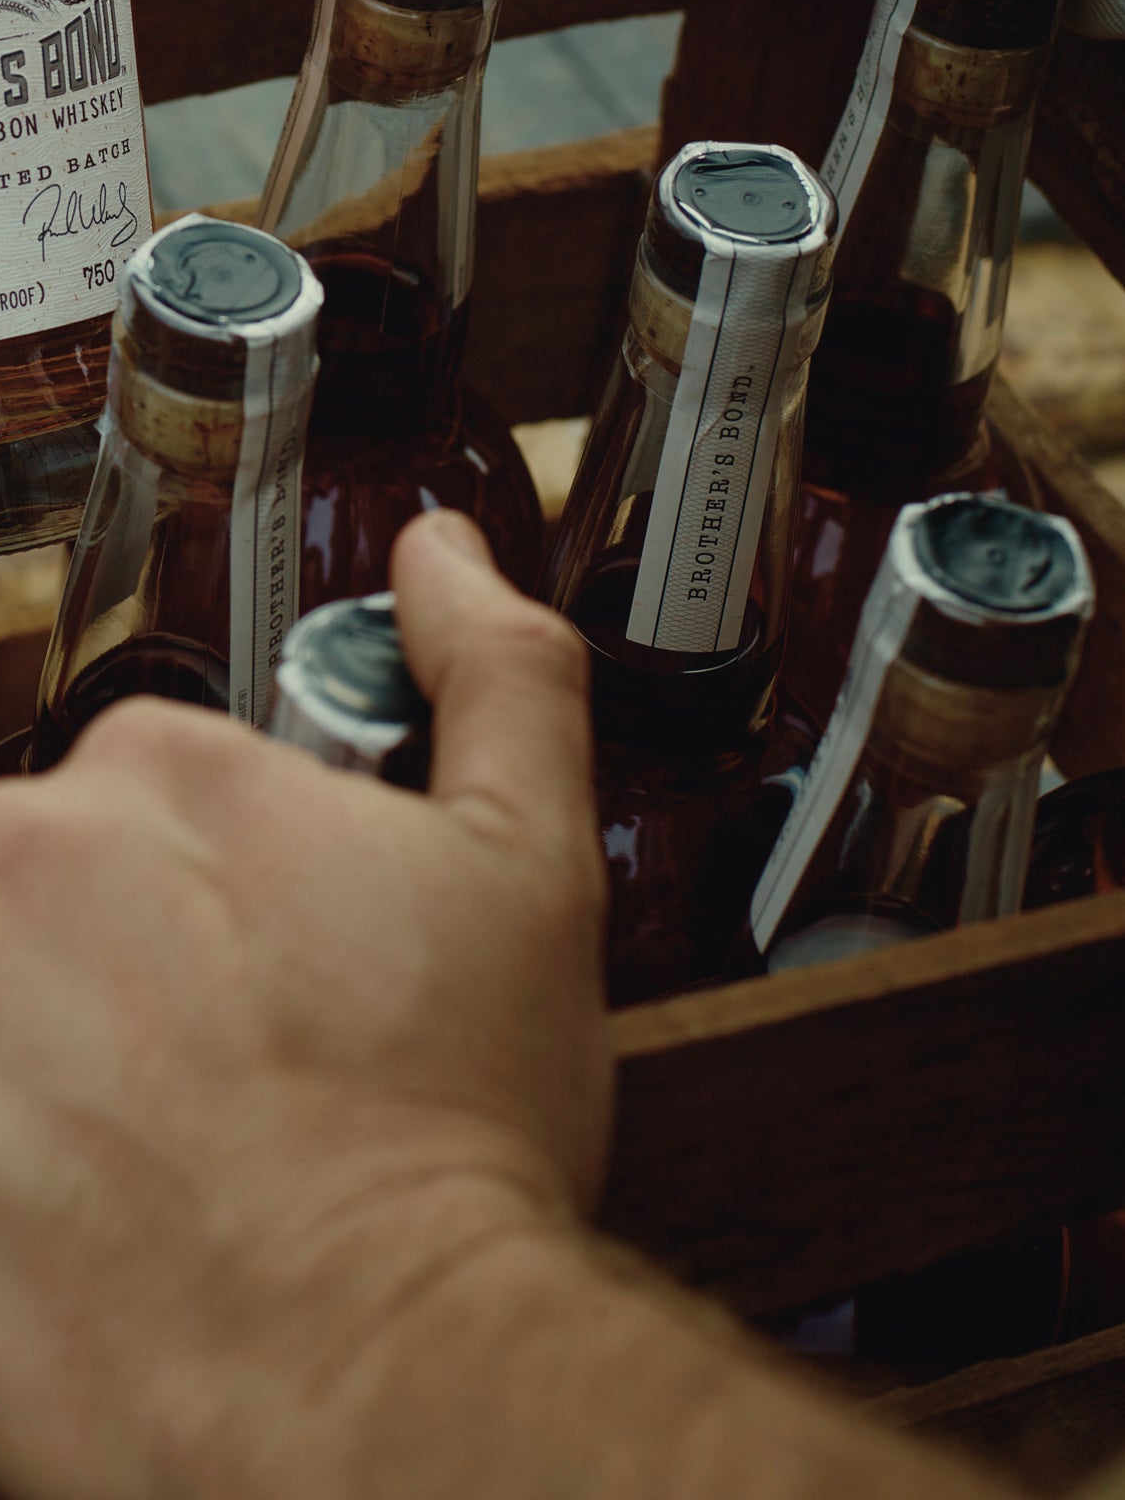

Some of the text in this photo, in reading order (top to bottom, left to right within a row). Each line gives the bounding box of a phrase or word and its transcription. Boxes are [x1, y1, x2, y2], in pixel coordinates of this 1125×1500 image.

[52, 86, 125, 131] WHISKEY
[66, 138, 132, 175] BATCH
[82, 258, 116, 290] 750
[687, 374, 754, 602] BROTHER'S BOND
